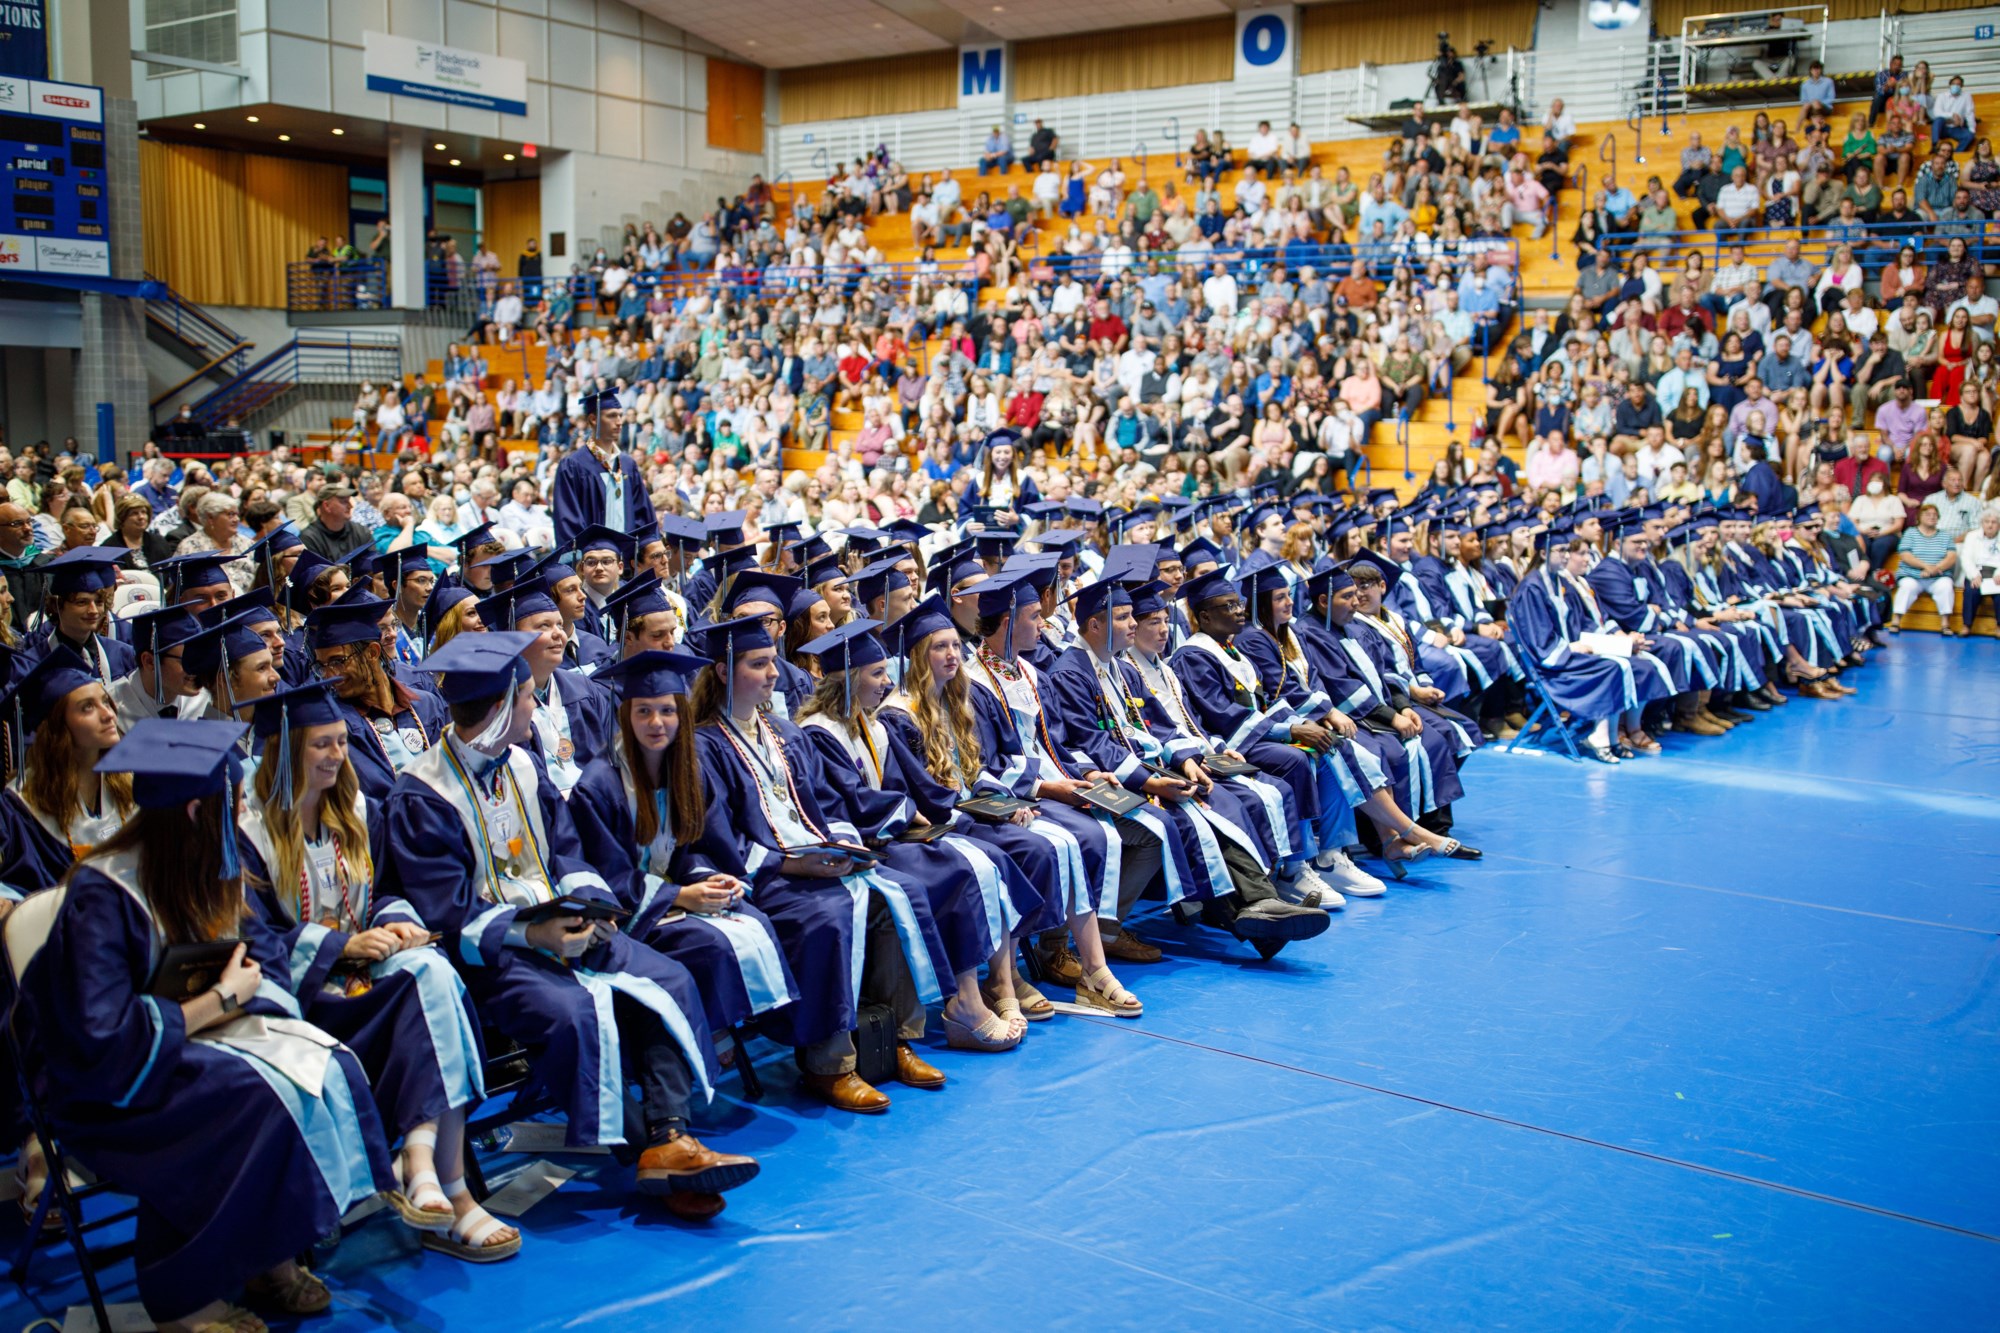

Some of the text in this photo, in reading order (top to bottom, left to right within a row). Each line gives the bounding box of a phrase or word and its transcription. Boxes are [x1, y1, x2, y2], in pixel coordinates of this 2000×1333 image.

[1978, 27, 1991, 38] 15
[1242, 14, 1286, 66] O
[963, 48, 1004, 96] M
[44, 95, 89, 108] SHEETZ
[17, 158, 48, 171] period
[19, 179, 49, 191] player
[23, 219, 47, 230] game
